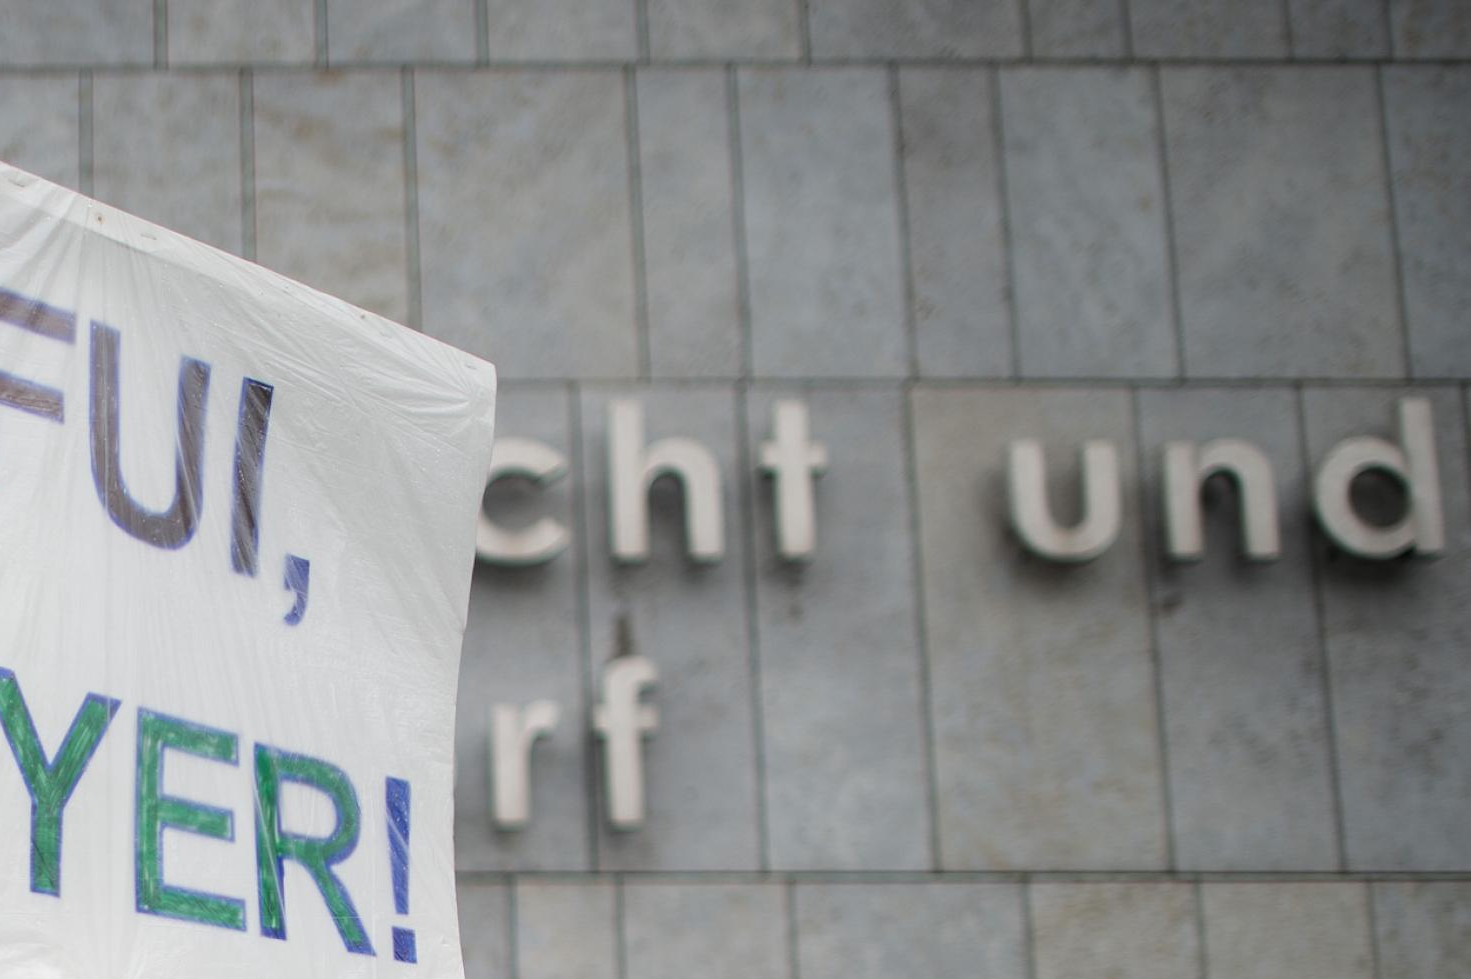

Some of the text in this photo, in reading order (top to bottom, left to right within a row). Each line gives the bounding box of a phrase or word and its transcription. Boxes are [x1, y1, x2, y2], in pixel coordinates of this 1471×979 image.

[475, 398, 829, 565] cht
[1006, 396, 1446, 565] und
[489, 654, 662, 830] rf
